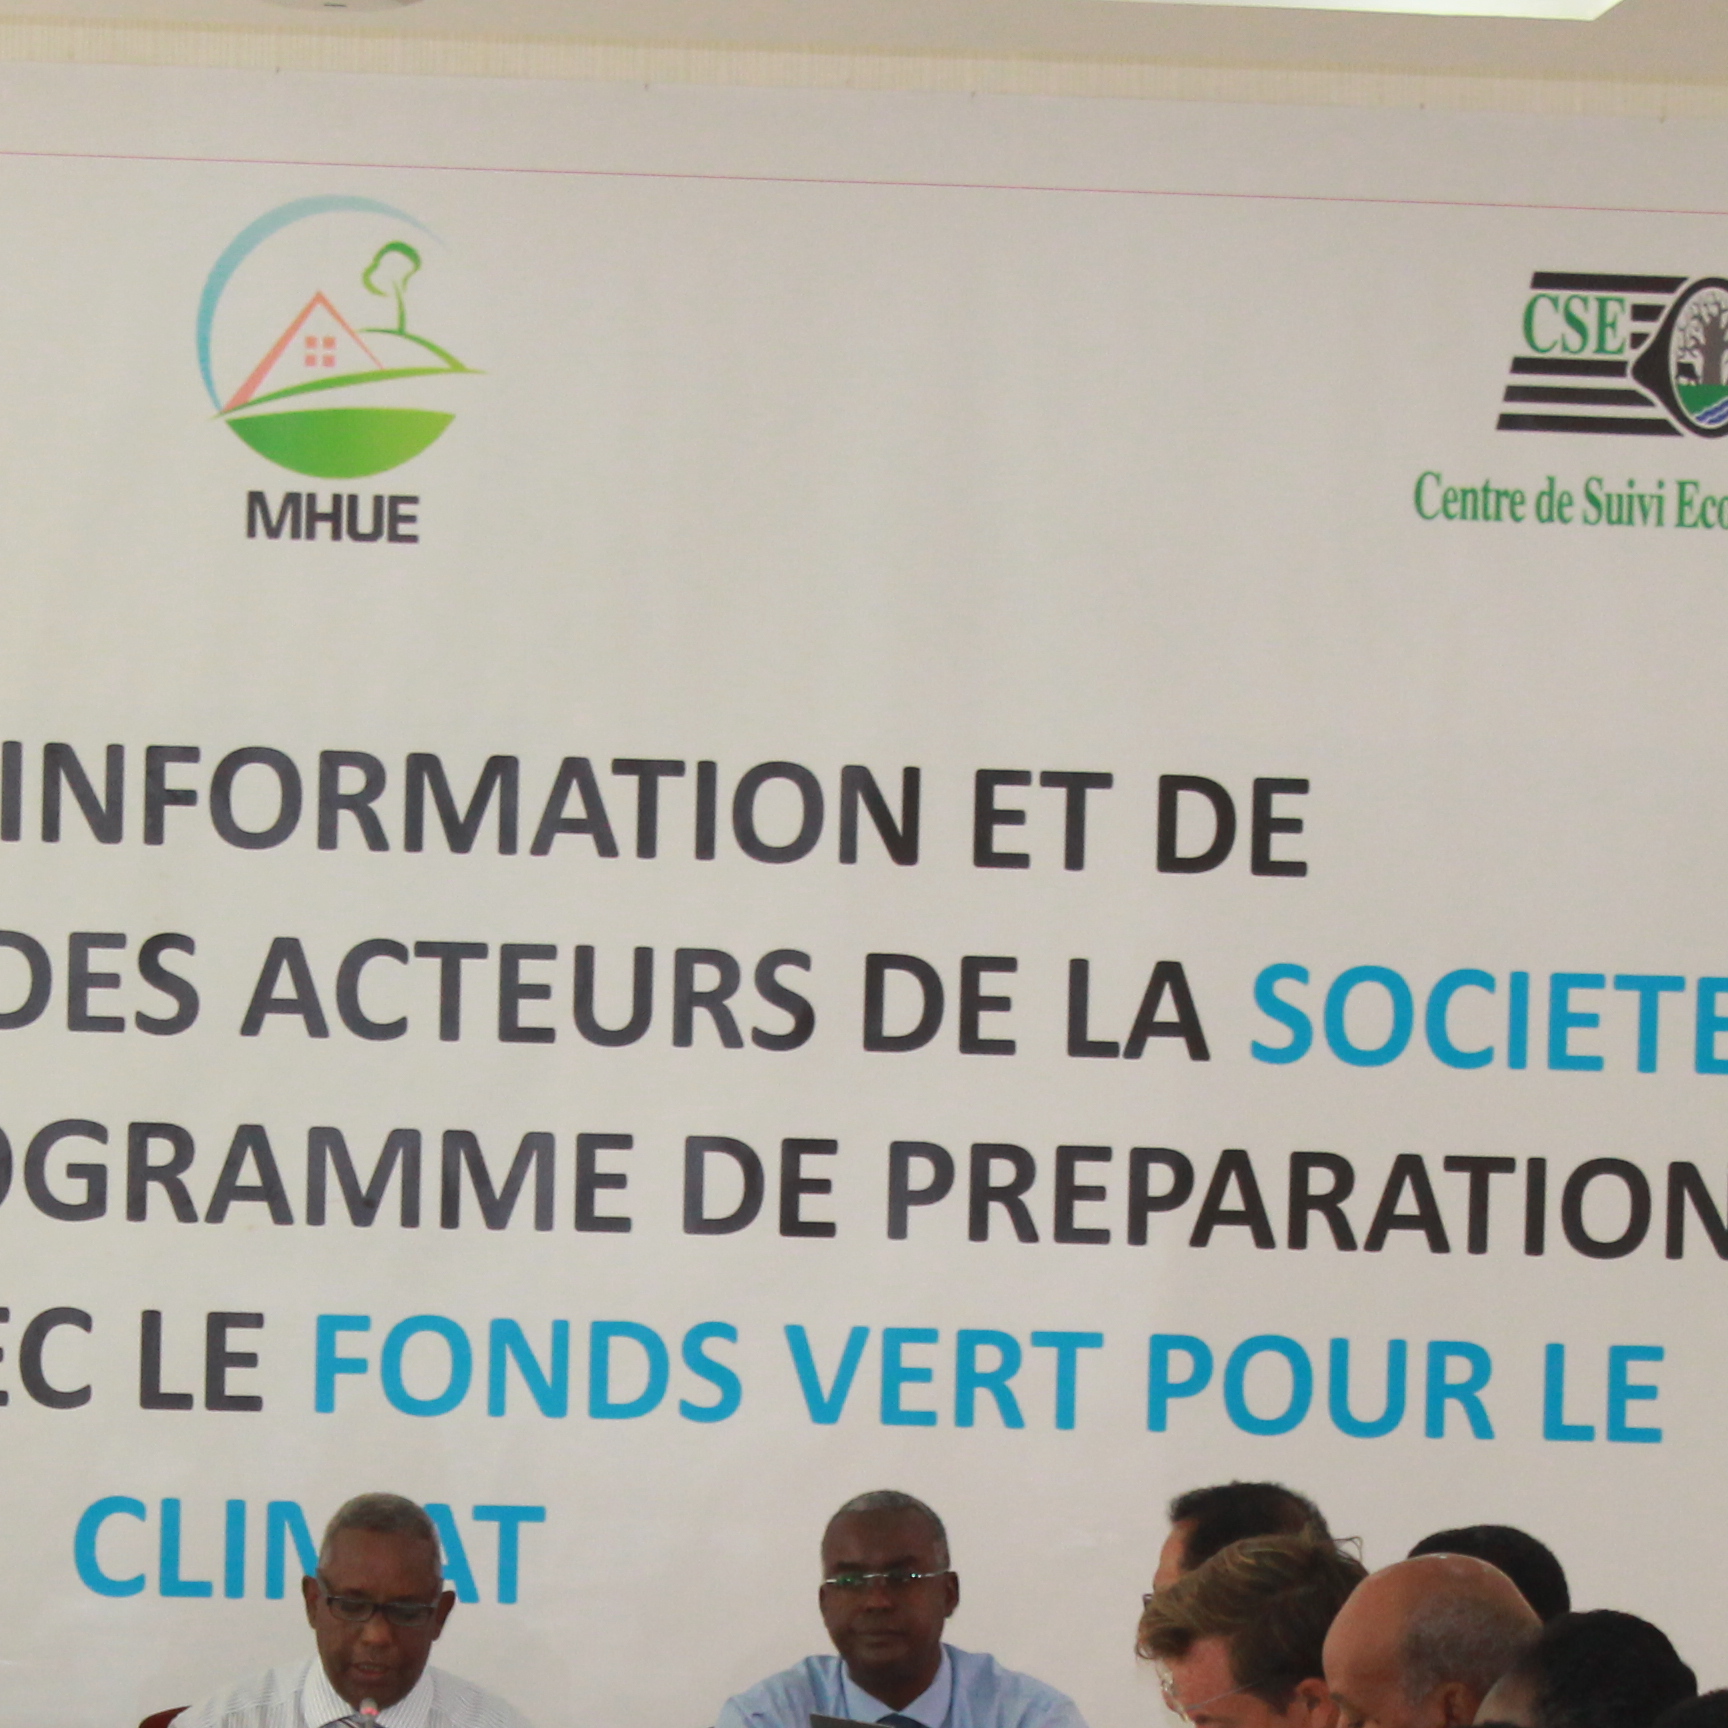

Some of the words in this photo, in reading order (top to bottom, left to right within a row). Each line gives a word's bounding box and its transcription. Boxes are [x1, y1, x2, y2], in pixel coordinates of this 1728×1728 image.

[1522, 292, 1626, 355] CSE
[245, 489, 421, 544] MHUE
[1413, 470, 1526, 523] Centre
[1534, 475, 1574, 525] de
[1582, 476, 1666, 527] Suivi
[972, 767, 1115, 873] ET
[1154, 772, 1312, 879] DE
[238, 936, 817, 1053] ACTEURS
[862, 951, 1020, 1056] DE
[1065, 957, 1213, 1062] LA
[681, 1134, 840, 1240] DE
[137, 1308, 266, 1413] LE
[313, 1313, 744, 1424] FONDS
[783, 1323, 1106, 1432] VERT
[1145, 1332, 1497, 1442] POUR
[1541, 1342, 1667, 1445] LE
